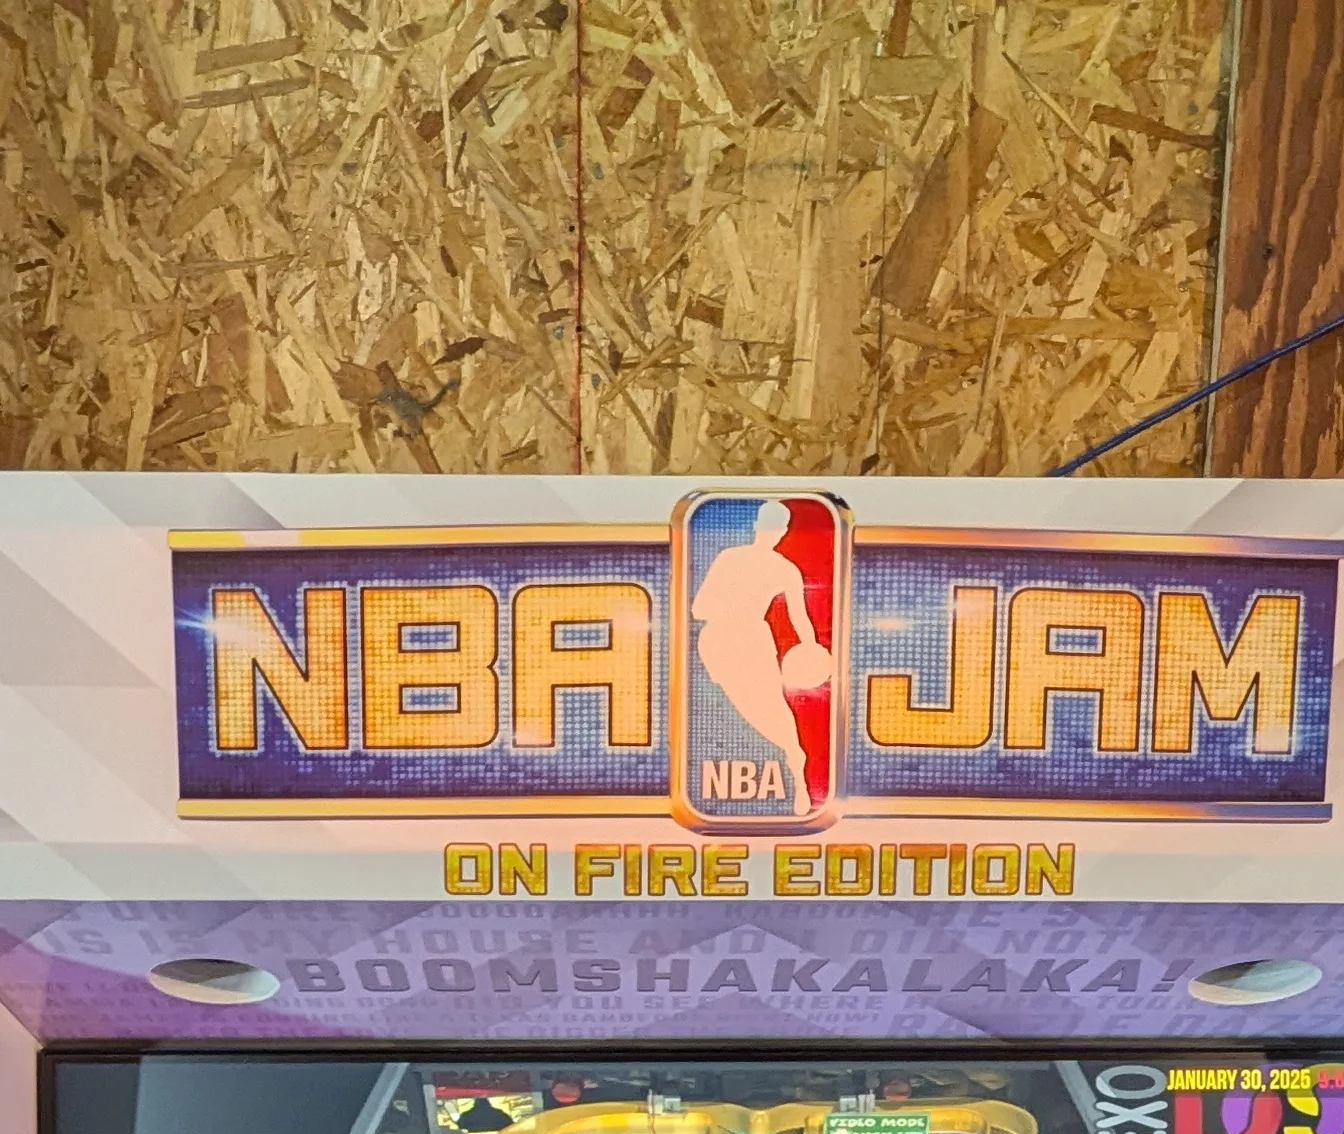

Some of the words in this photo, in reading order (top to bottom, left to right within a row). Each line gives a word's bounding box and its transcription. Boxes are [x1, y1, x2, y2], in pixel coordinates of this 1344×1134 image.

[212, 583, 654, 752] NBA
[866, 585, 1302, 754] JAM
[701, 761, 787, 802] NBA
[444, 843, 549, 898] ON
[573, 843, 749, 898] FIRE
[772, 843, 1077, 898] EDITION
[372, 928, 599, 954] HOUSE
[285, 957, 1195, 992] BOOMSHAKALAKA!
[1166, 1069, 1238, 1091] JANUARY
[1240, 1069, 1266, 1093] 30,
[829, 1117, 877, 1128] VIDEO
[880, 1117, 926, 1128] MODE
